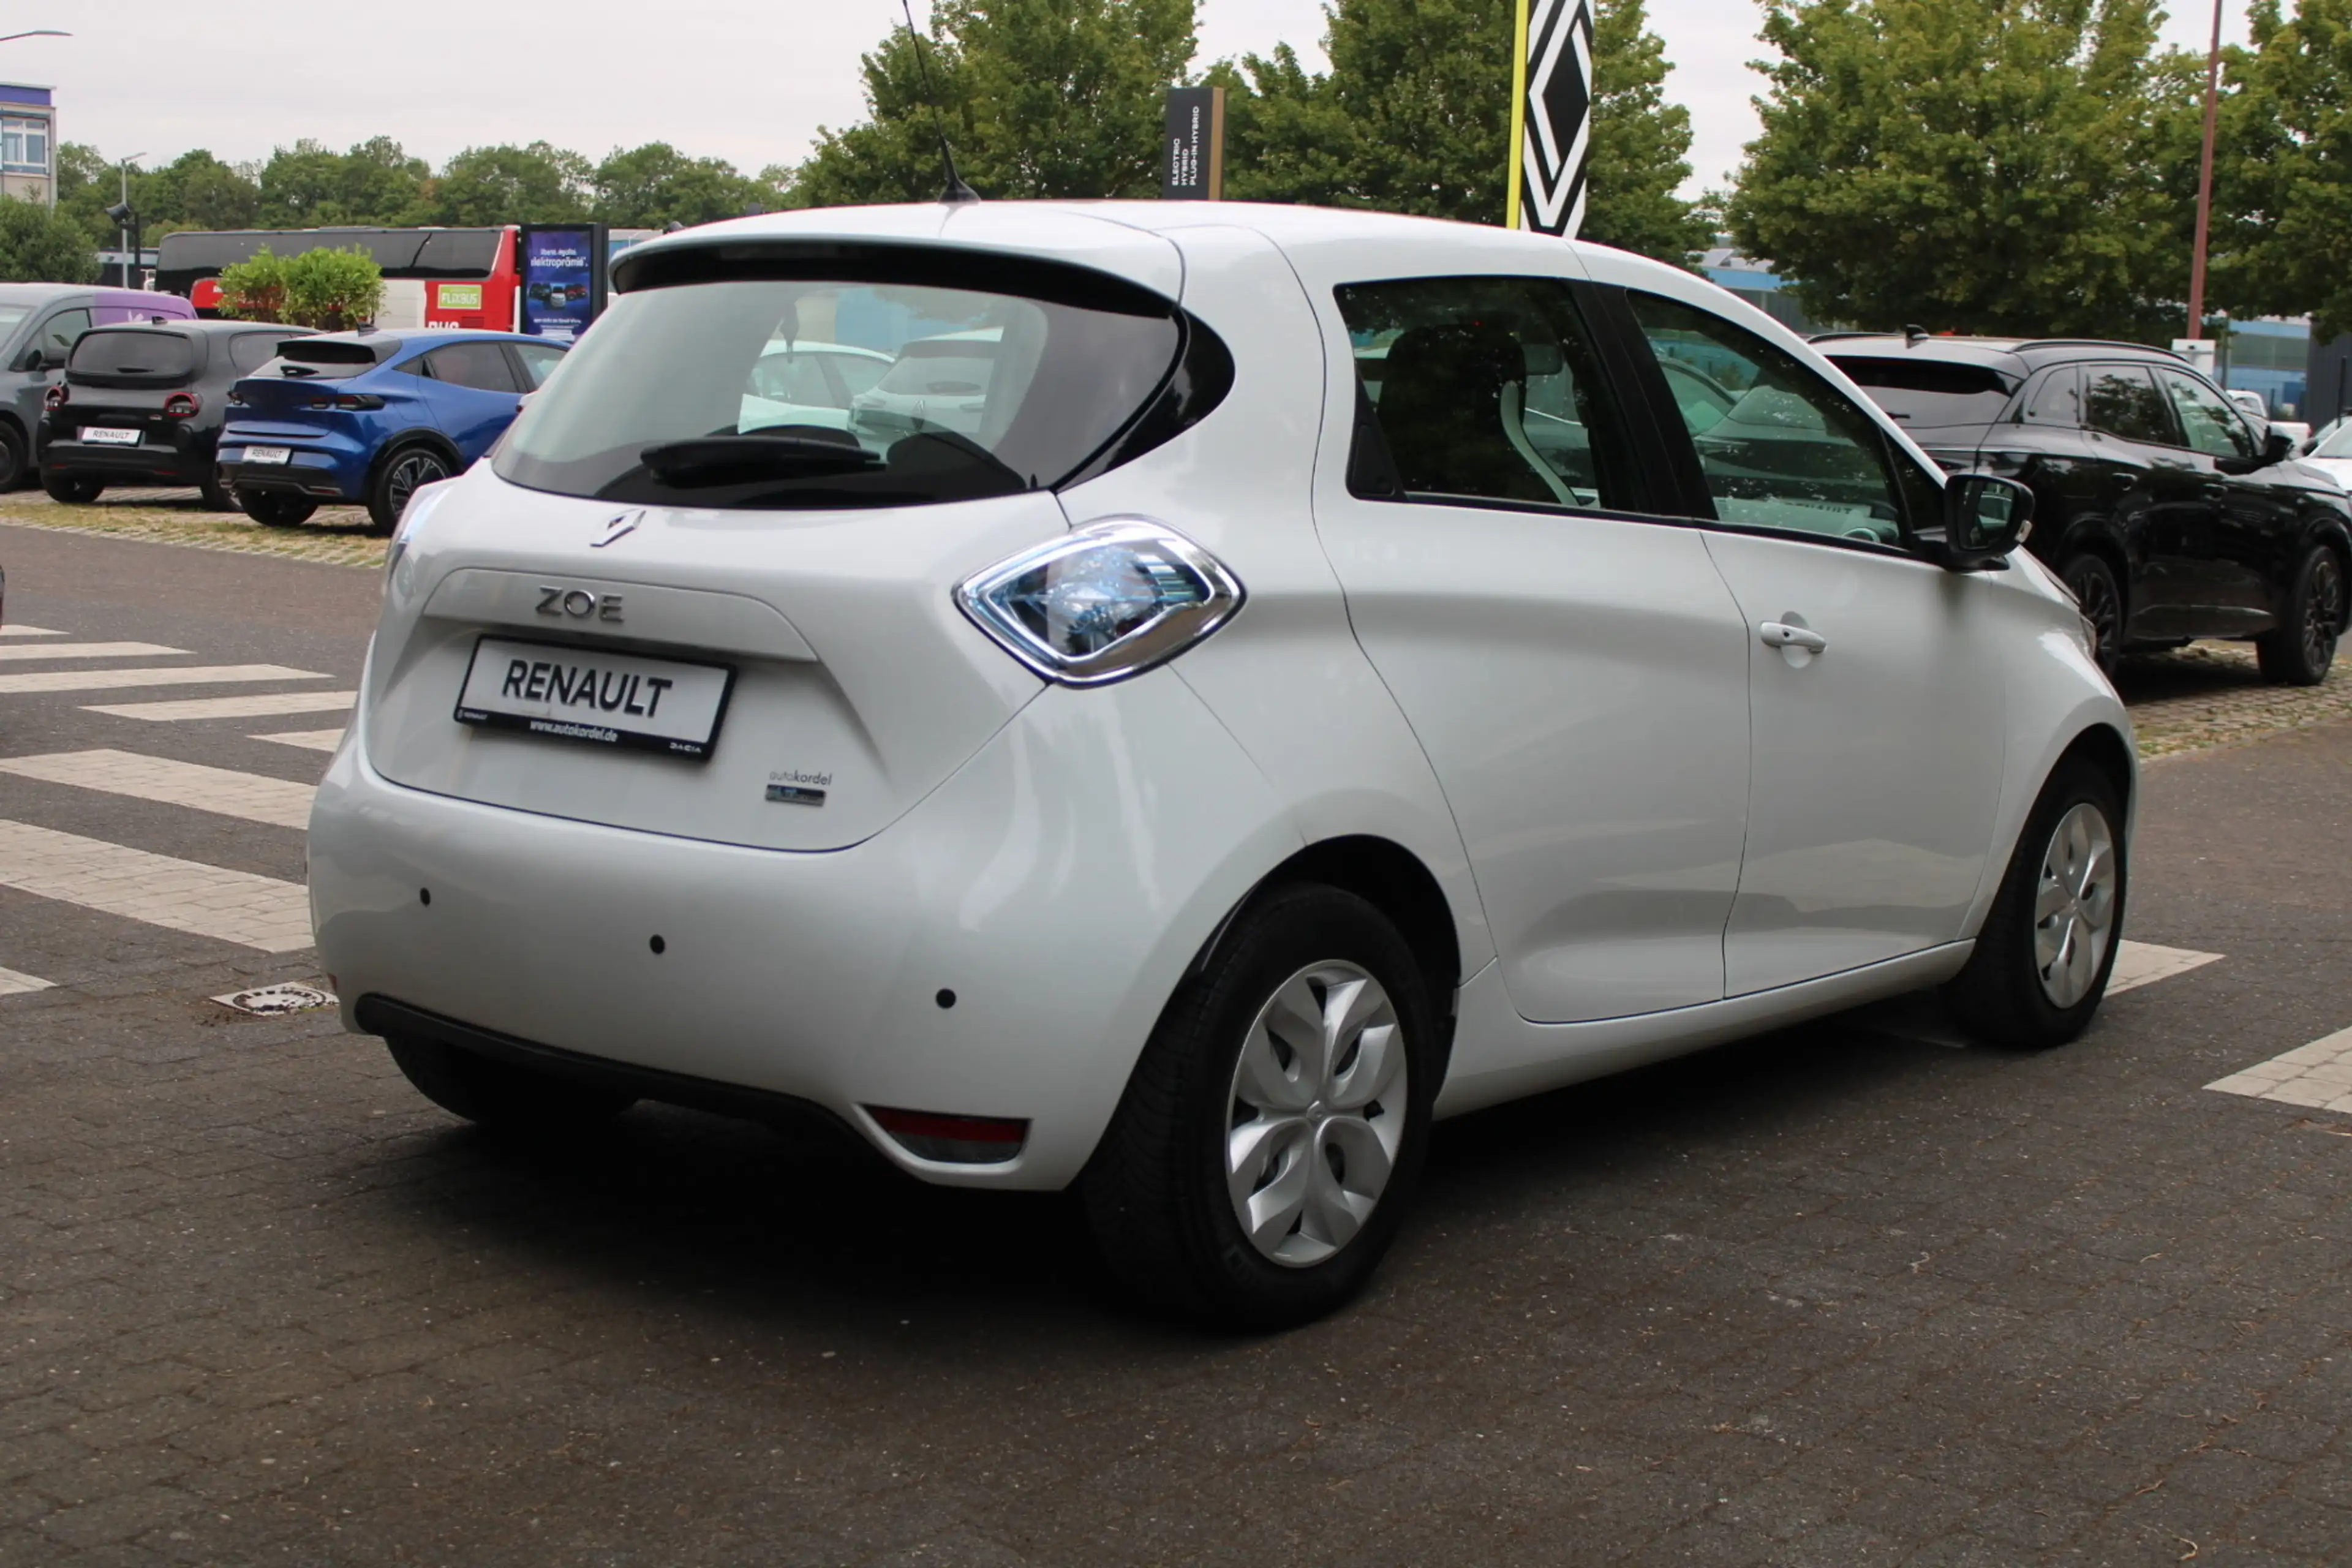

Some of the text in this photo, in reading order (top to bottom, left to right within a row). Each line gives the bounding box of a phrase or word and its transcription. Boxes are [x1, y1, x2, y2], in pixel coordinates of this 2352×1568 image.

[1172, 138, 1180, 186] ELECTRIC
[1189, 145, 1198, 186] PLUG-IN
[441, 292, 478, 304] FLIXBUS
[252, 447, 283, 458] RENAULT
[535, 584, 624, 623] ZOE
[502, 658, 673, 718] RENAULT
[530, 720, 618, 742] www.autokordel.de
[669, 742, 702, 753] DACIA
[769, 769, 832, 785] autokordel
